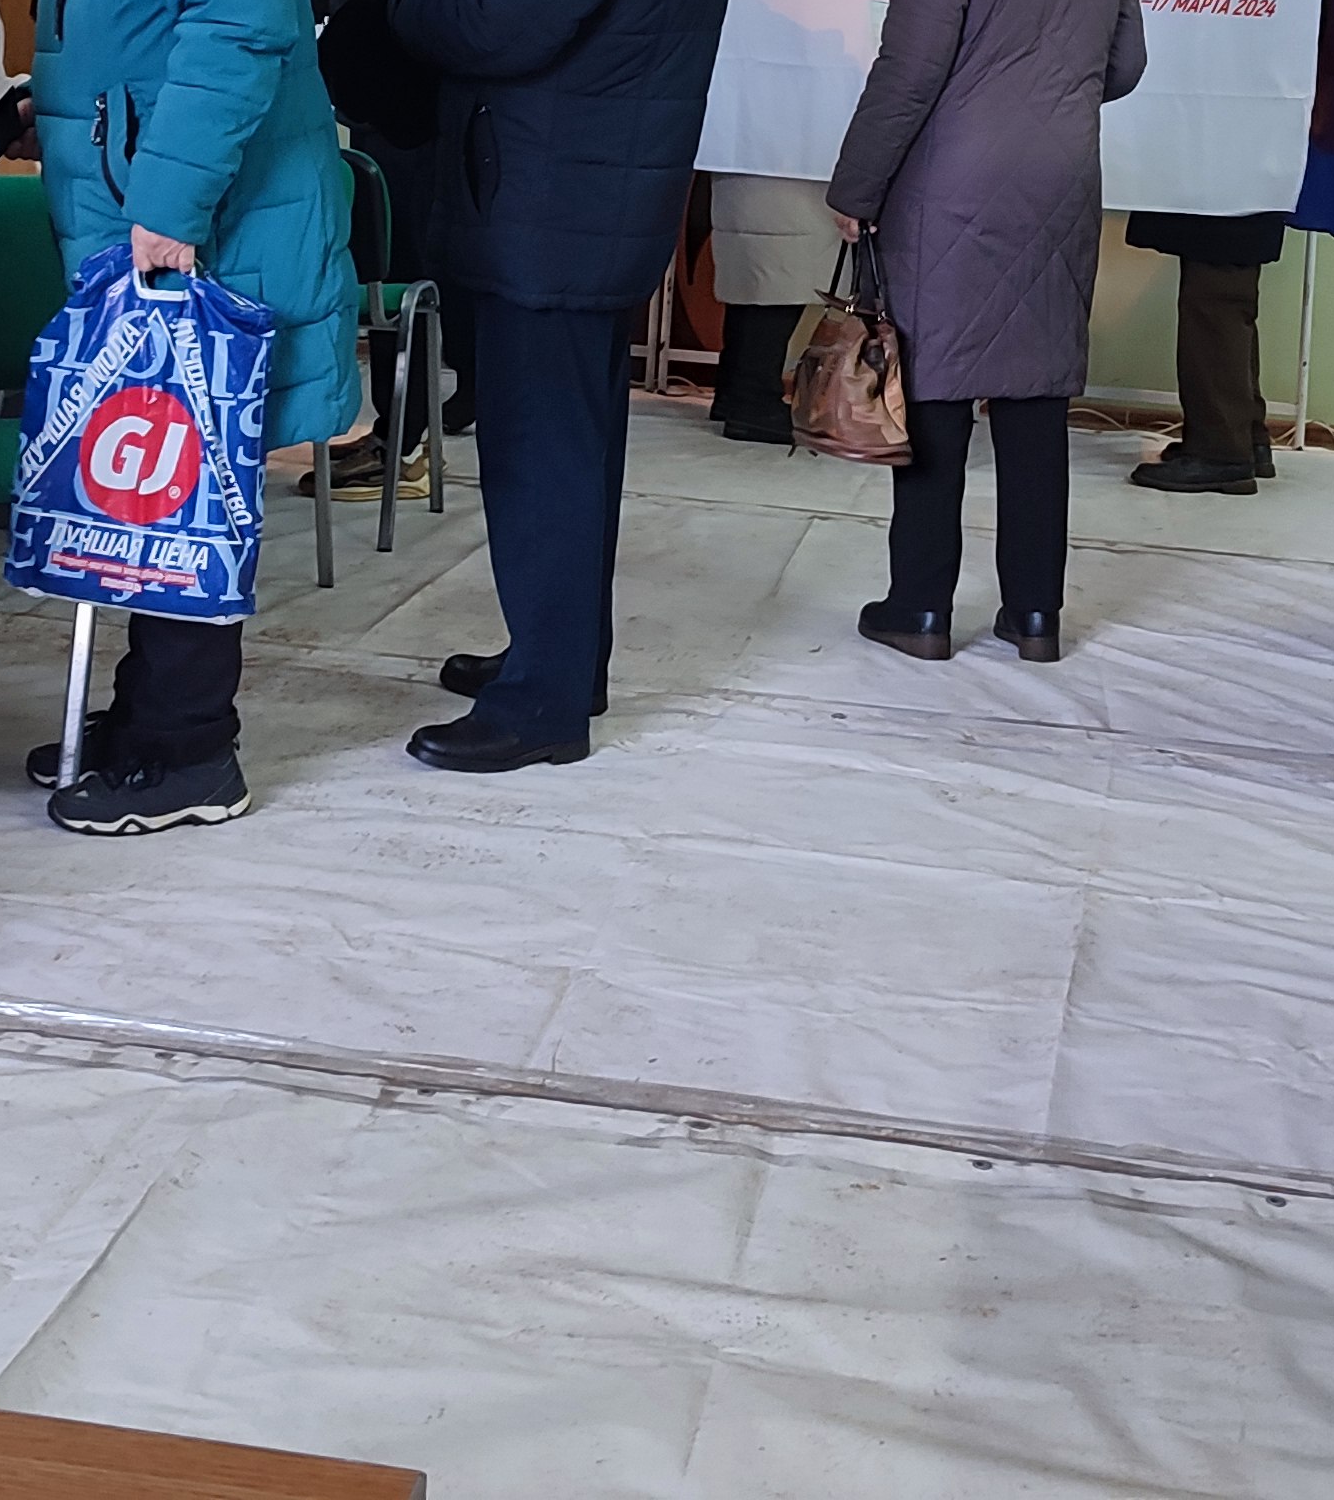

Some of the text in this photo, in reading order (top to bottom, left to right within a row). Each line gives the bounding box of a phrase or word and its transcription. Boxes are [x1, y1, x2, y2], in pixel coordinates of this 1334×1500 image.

[85, 320, 142, 388] МОДА
[44, 522, 144, 561] ЛУЧШАЯ
[148, 539, 209, 570] ЦЕНА
